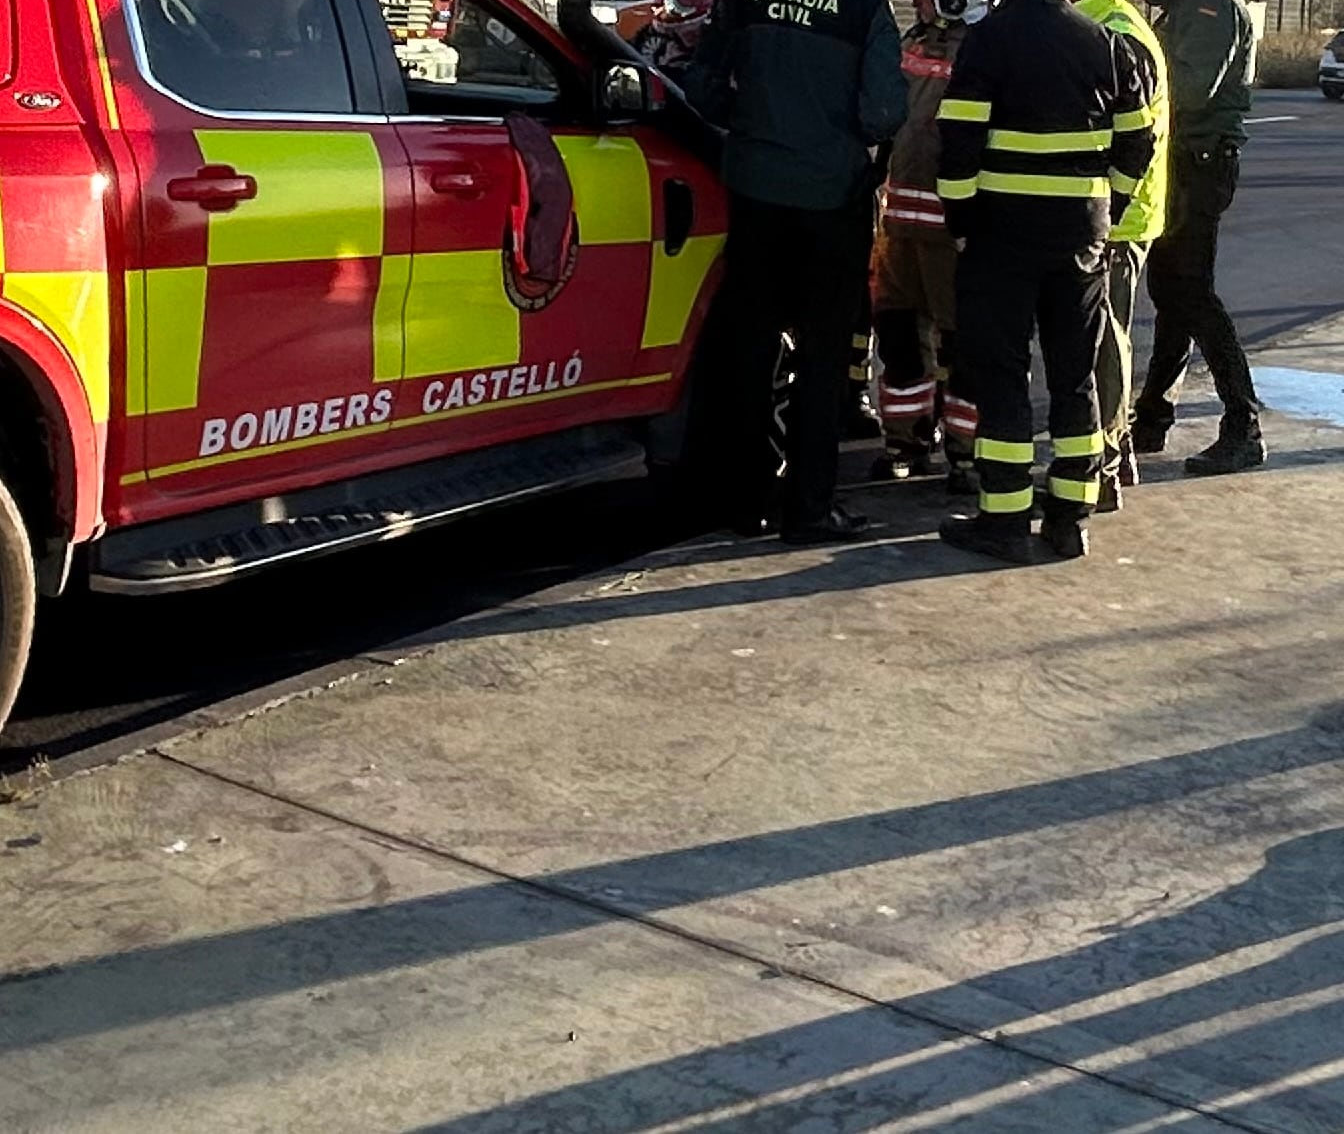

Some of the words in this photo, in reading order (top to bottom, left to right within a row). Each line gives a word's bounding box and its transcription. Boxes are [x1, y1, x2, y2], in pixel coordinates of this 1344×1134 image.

[767, 2, 812, 26] CIVIL
[198, 387, 394, 457] BOMBERS
[421, 348, 584, 414] CASTELLÓ
